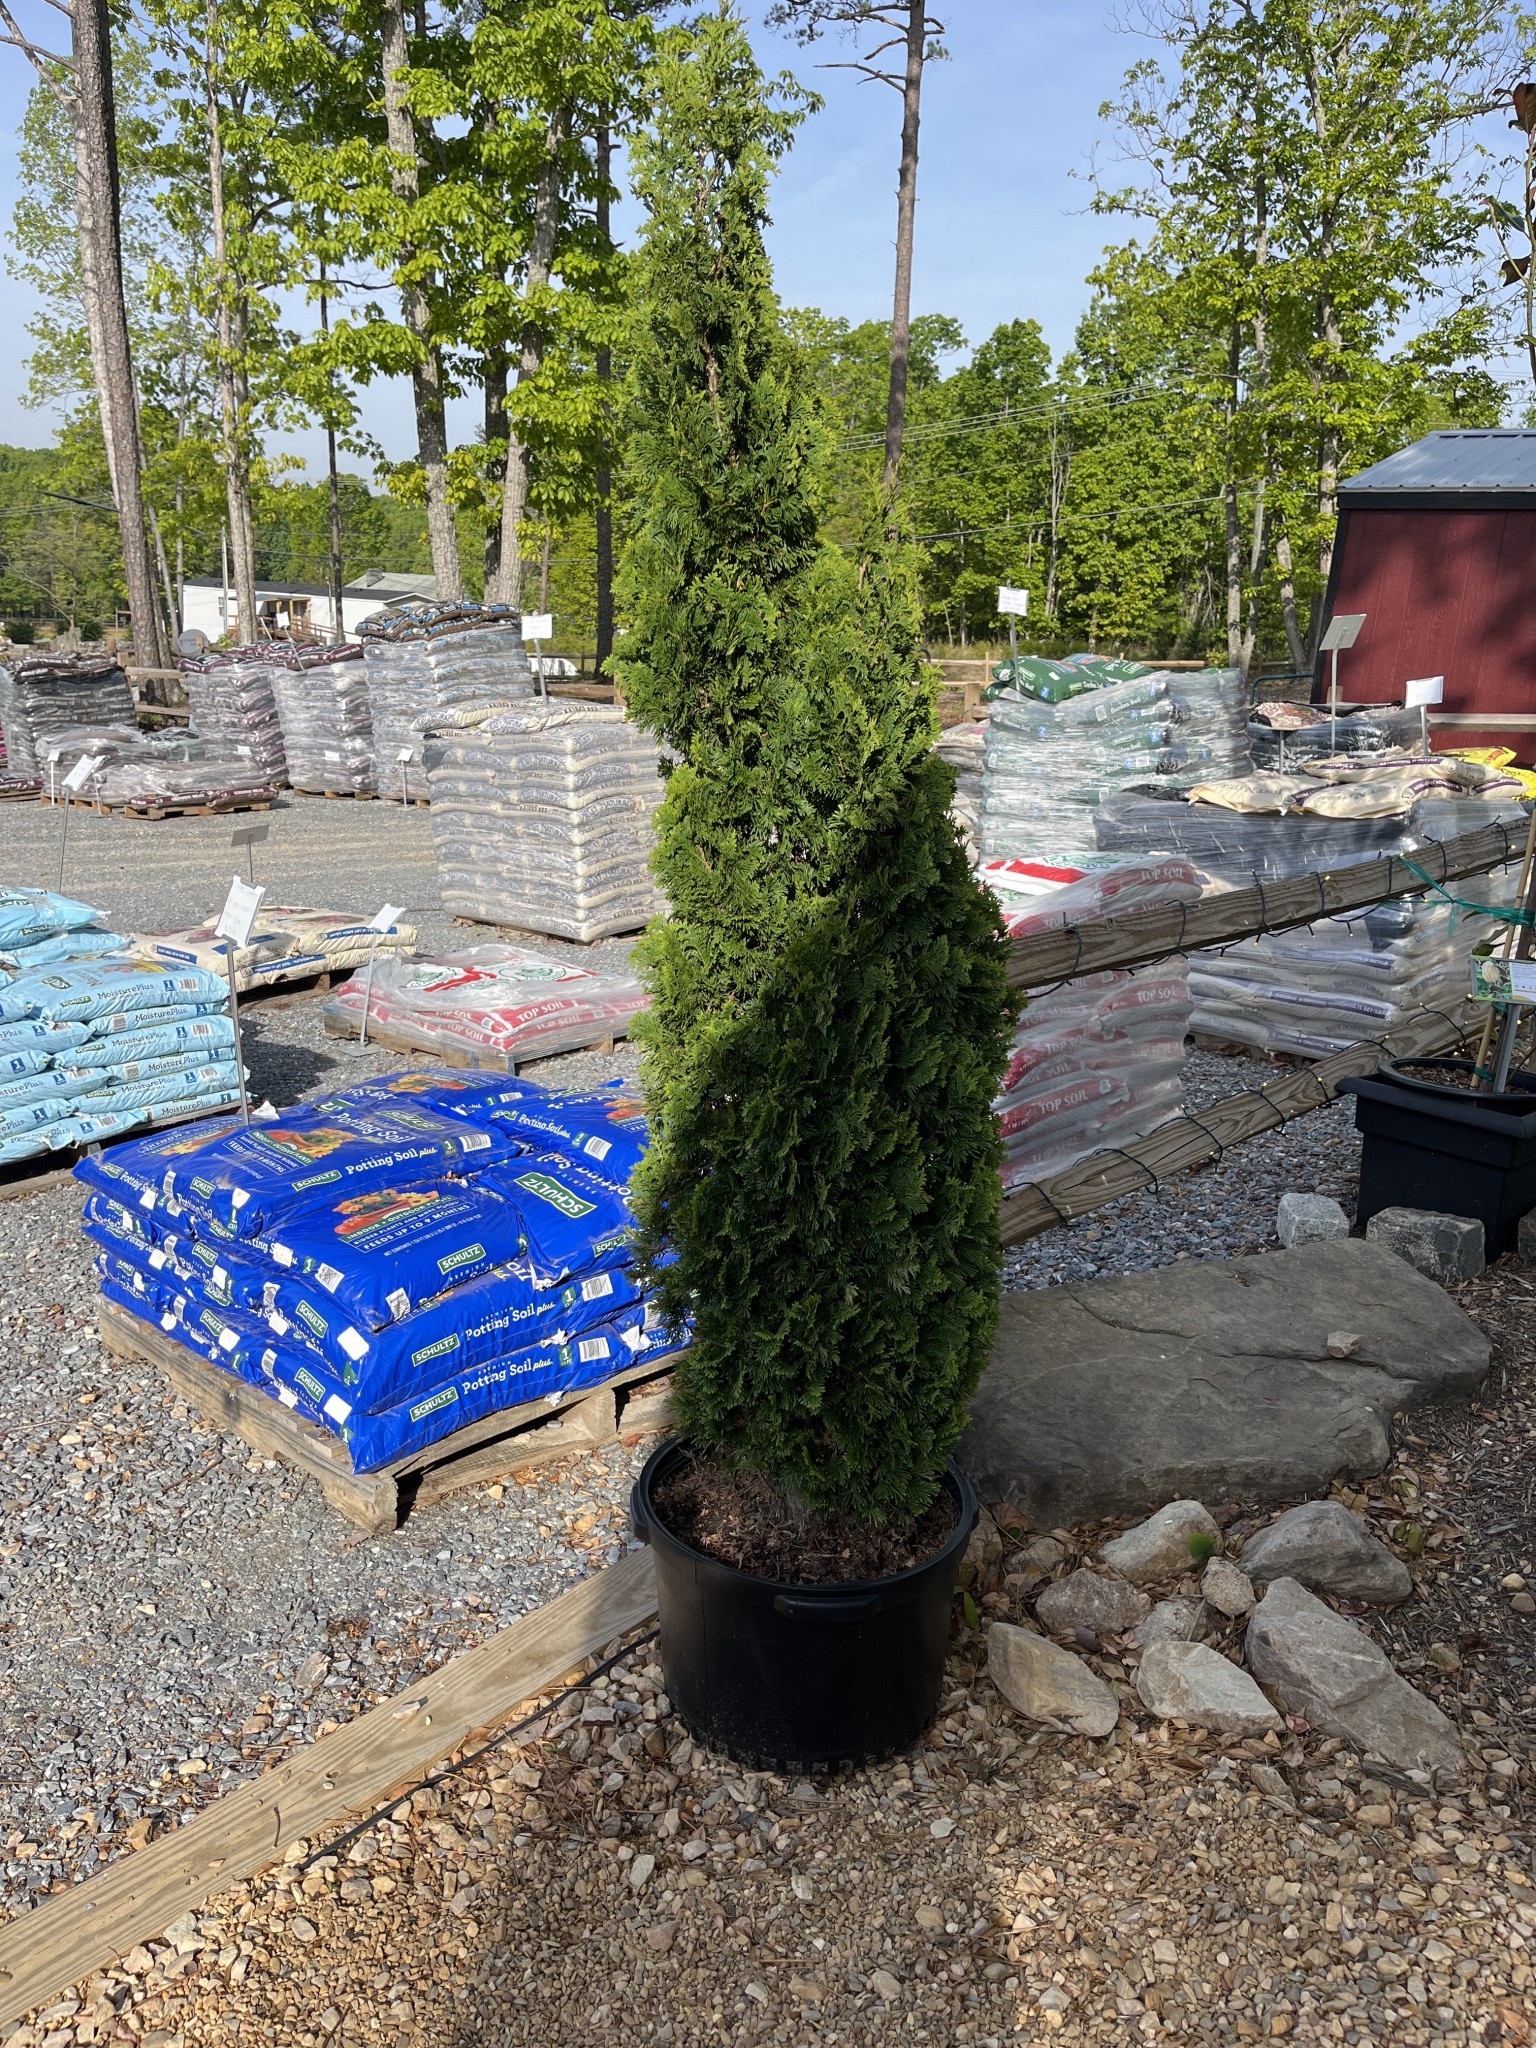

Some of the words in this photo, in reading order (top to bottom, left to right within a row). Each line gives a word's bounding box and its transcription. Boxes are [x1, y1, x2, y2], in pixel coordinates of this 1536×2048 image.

[1141, 867, 1161, 881] TOP
[1163, 865, 1185, 880] SOIL
[97, 983, 155, 1001] MoisturePlus
[1137, 988, 1157, 1003] TOP
[135, 1007, 188, 1022] MoisturePlus
[516, 1007, 540, 1022] TOP
[542, 1000, 565, 1014] SOIL
[112, 1031, 168, 1047] MoisturePlus
[465, 1029, 484, 1042] SOIL
[1046, 1040, 1067, 1053] TOP
[148, 1055, 200, 1071] MoisturePlus
[1046, 1061, 1072, 1079] SOIL
[121, 1076, 177, 1093] MoisturePlus
[161, 1099, 212, 1115] MoisturePlus
[1039, 1099, 1062, 1115] TOP
[1064, 1089, 1089, 1107] SOIL
[338, 1112, 382, 1134] Potting
[377, 1129, 417, 1143] Soil
[518, 1113, 547, 1131] Potting
[546, 1121, 562, 1136] Soil
[345, 1155, 393, 1175] Potting
[395, 1148, 419, 1162] Soil
[419, 1147, 438, 1159] plus
[120, 1171, 145, 1191] Potting
[193, 1178, 213, 1197] SCHULTZ
[297, 1171, 336, 1188] SCHULTZ
[523, 1178, 584, 1213] SCHULTZ
[347, 1222, 382, 1240] INDOOR
[387, 1204, 425, 1222] OUTDOOR
[363, 1234, 394, 1250] FEEDS
[394, 1228, 408, 1237] UP
[409, 1221, 424, 1231] TO
[432, 1204, 471, 1221] MONTHS
[353, 1232, 379, 1246] BIGGER
[380, 1221, 404, 1234] PLANTS
[195, 1244, 218, 1263] SCHULTZ
[442, 1246, 482, 1269] SCHULTZ
[563, 1288, 574, 1303] 1
[299, 1303, 324, 1332] SCHULTZ
[465, 1315, 509, 1341] Potting
[512, 1302, 536, 1322] Soil
[536, 1301, 557, 1316] plus
[416, 1337, 455, 1361] SCHULTZ
[561, 1348, 570, 1360] 1
[299, 1372, 323, 1397] SCHULTZ
[462, 1369, 506, 1395] Potting
[509, 1358, 532, 1376] Soil
[532, 1358, 553, 1372] plus
[414, 1390, 453, 1417] SCHULTZ
